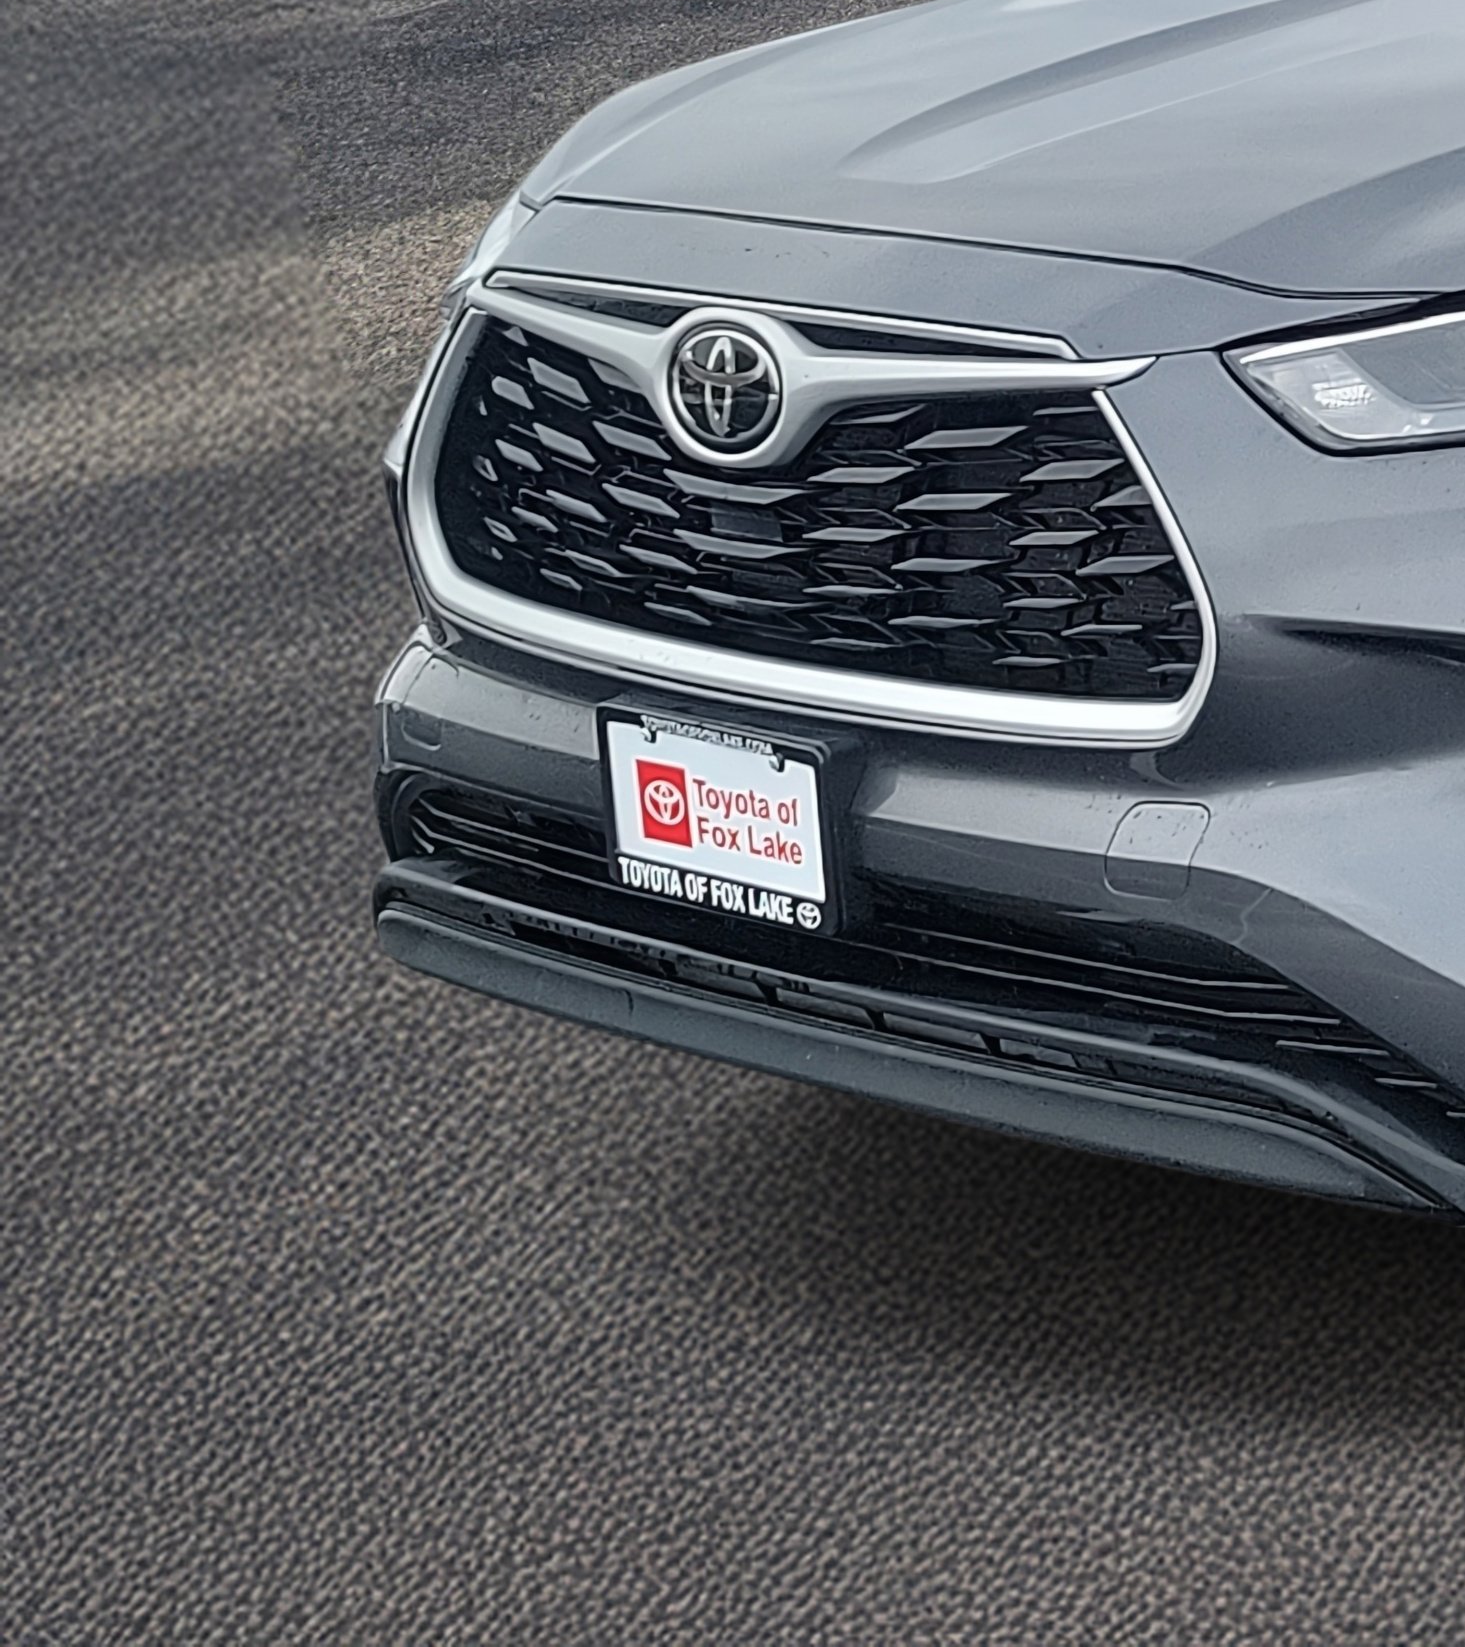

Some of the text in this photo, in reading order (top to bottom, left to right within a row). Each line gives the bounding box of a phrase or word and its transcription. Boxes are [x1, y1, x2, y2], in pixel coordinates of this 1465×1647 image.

[692, 778, 799, 826] Toyota of
[697, 816, 803, 865] Fox Lake
[617, 856, 795, 925] TOYOTA OF FOX LAKE
